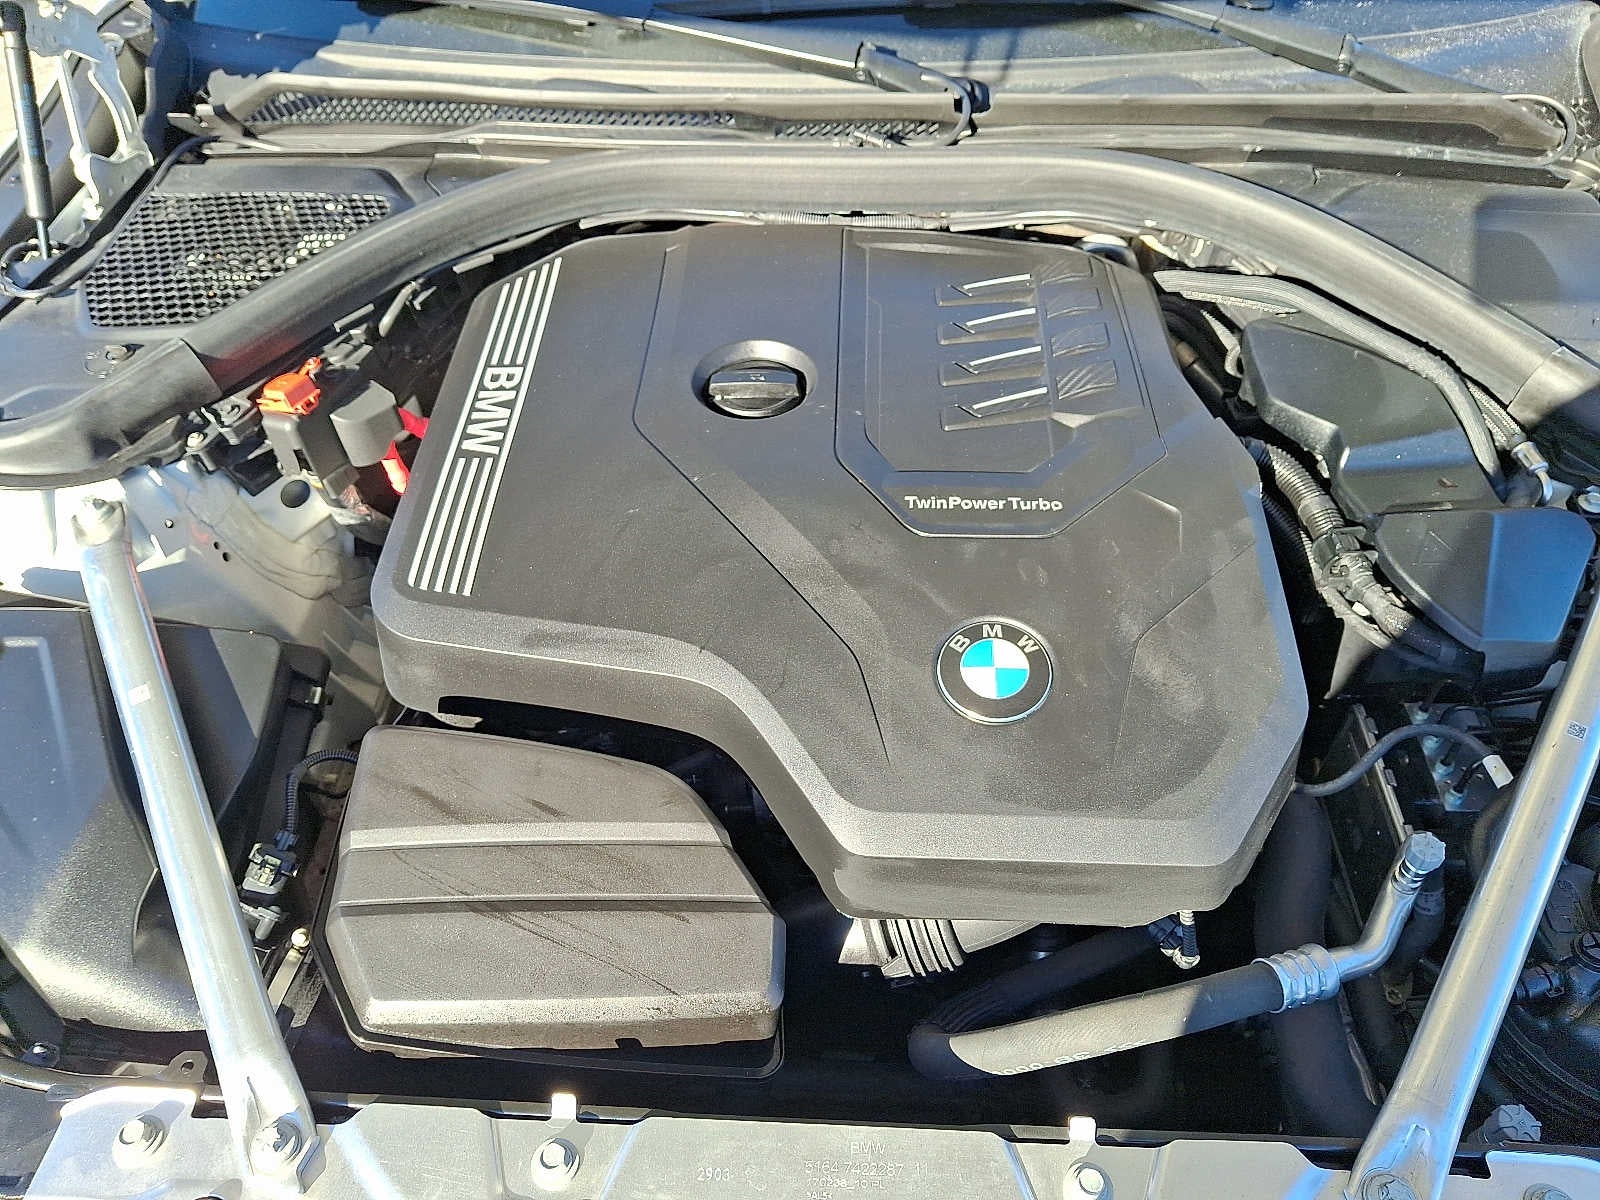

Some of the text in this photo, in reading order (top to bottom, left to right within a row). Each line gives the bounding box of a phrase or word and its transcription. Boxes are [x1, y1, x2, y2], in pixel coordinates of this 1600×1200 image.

[461, 366, 525, 455] BMW
[1008, 497, 1064, 512] Turbo
[949, 623, 1040, 654] BMW
[850, 1141, 885, 1155] BMW
[696, 1167, 730, 1182] 2903
